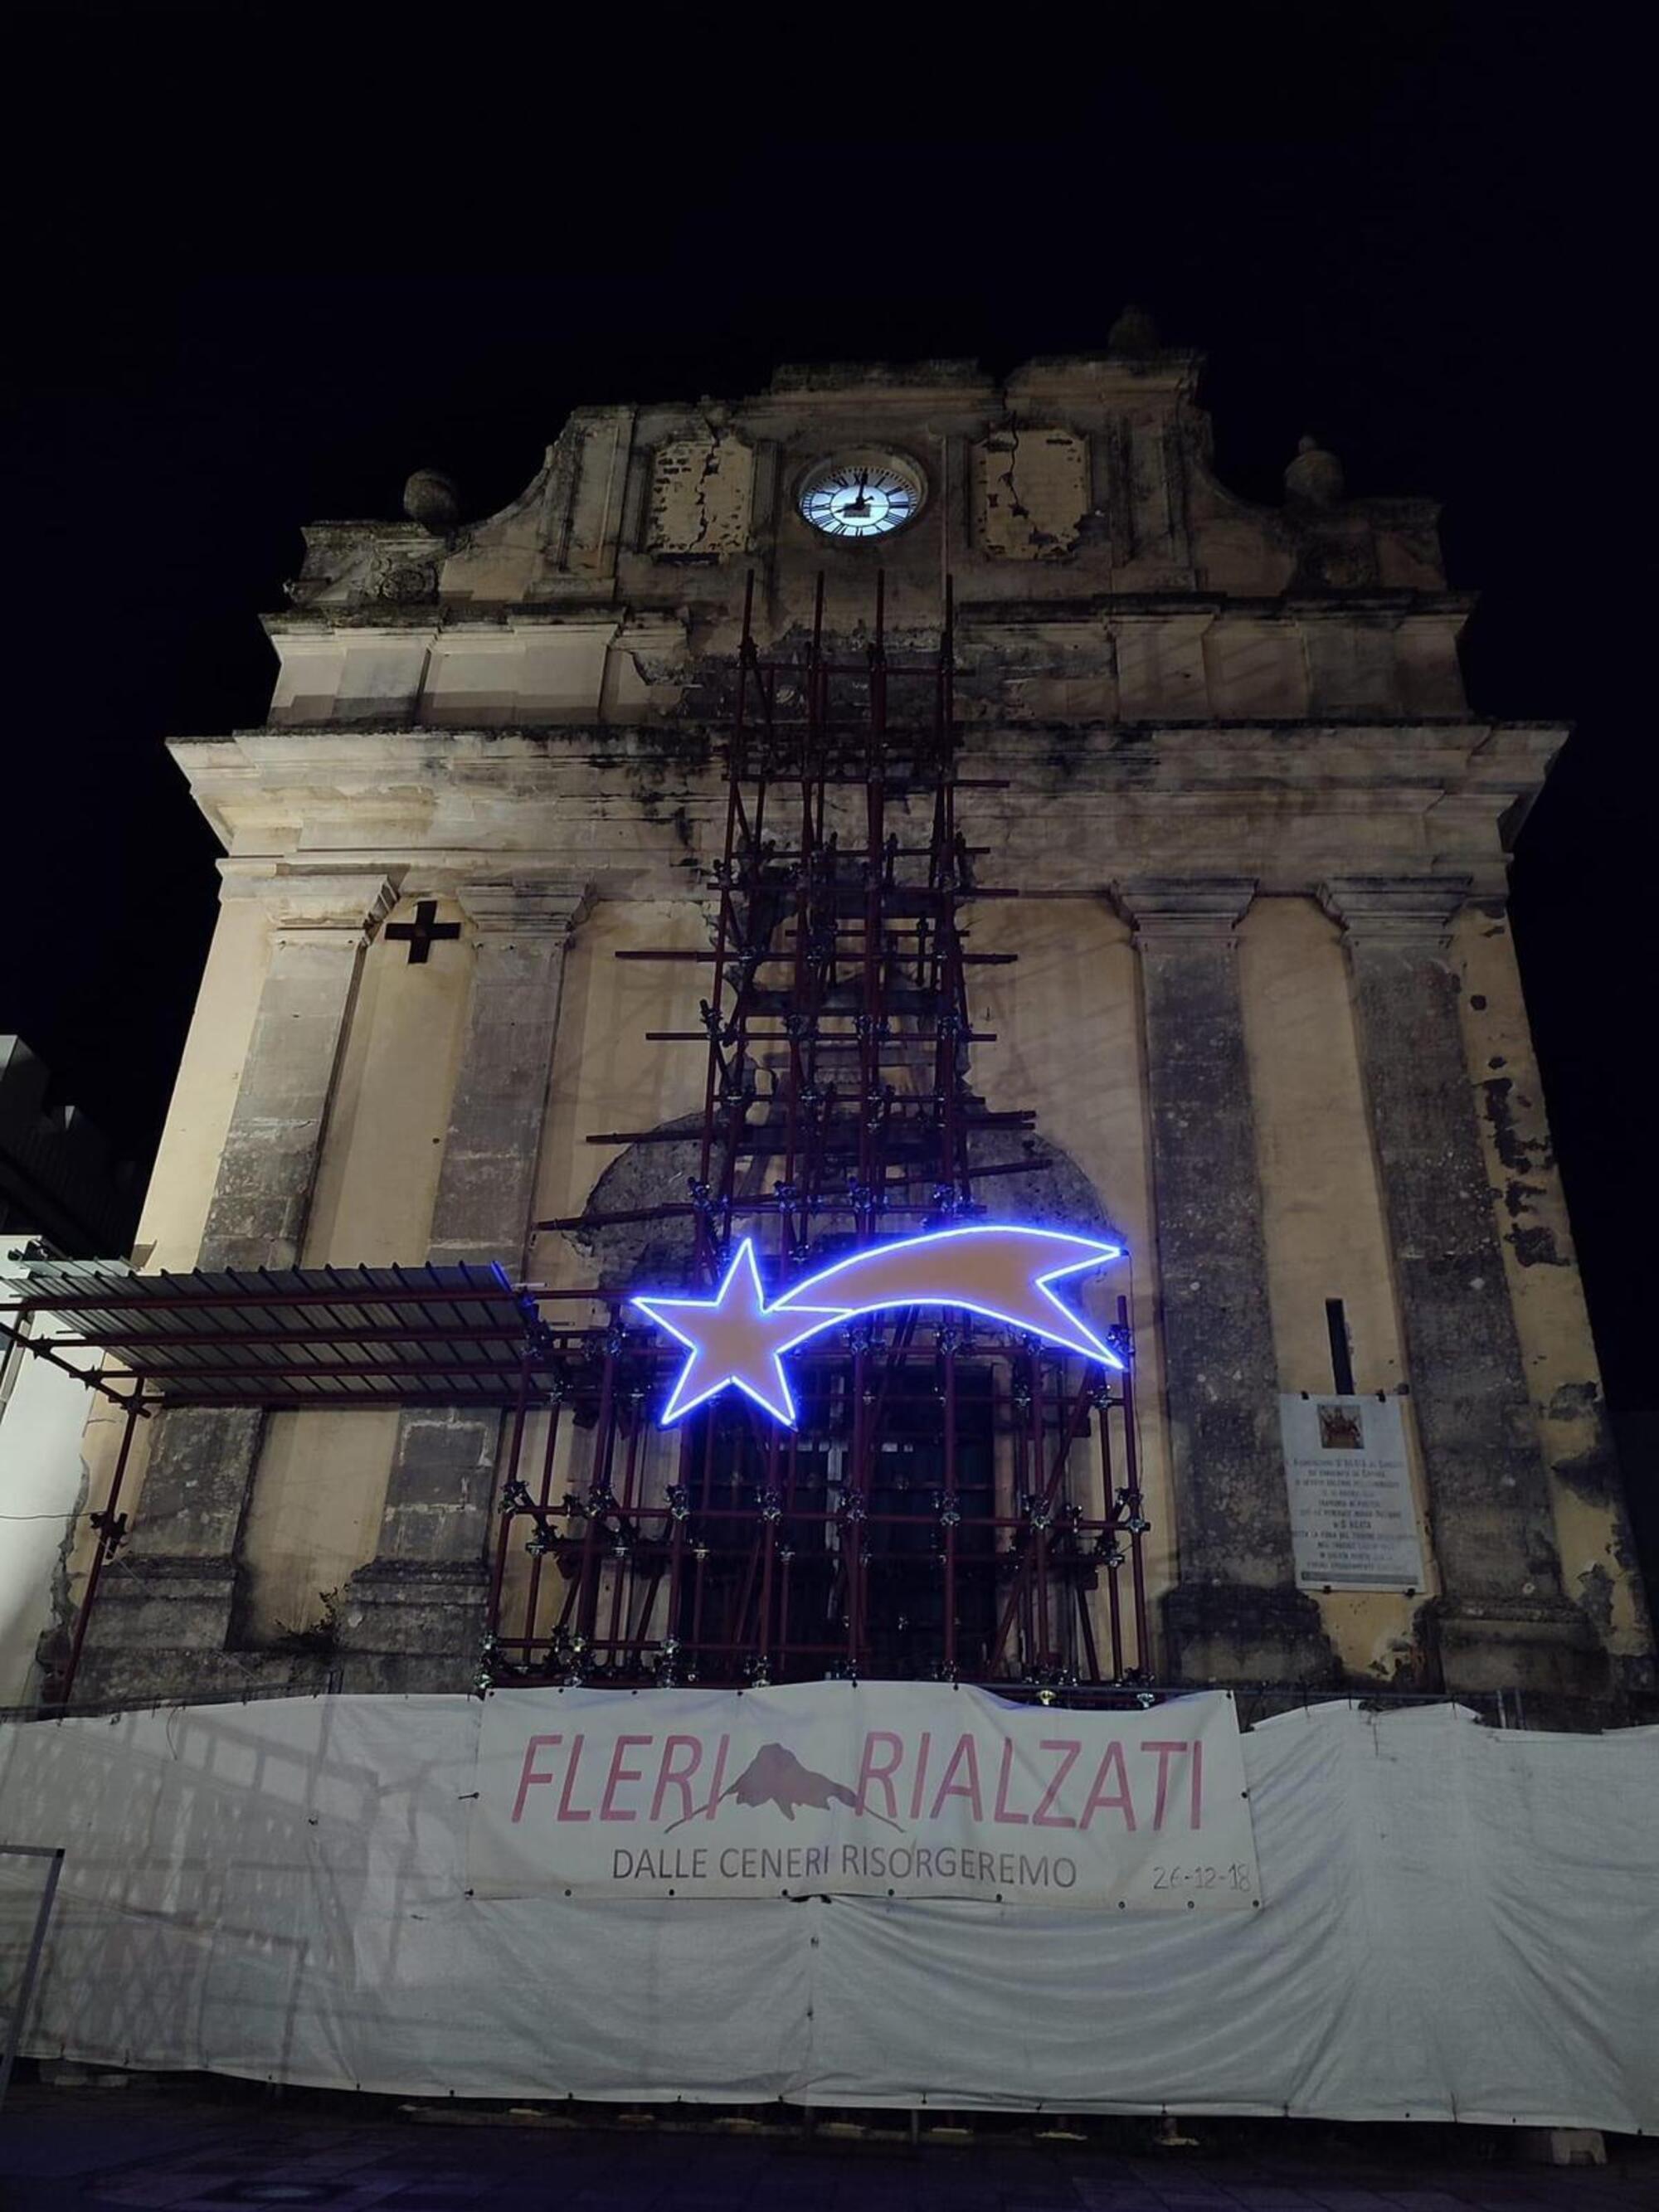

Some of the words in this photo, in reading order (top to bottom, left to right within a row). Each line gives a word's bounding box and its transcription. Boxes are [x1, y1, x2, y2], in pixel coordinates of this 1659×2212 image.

[512, 1733, 730, 1823] FLERI
[854, 1731, 1203, 1831] RIALZATI
[612, 1848, 708, 1879] DALLE
[719, 1845, 830, 1879] CENERI
[842, 1844, 1077, 1888] RISORGEREMO
